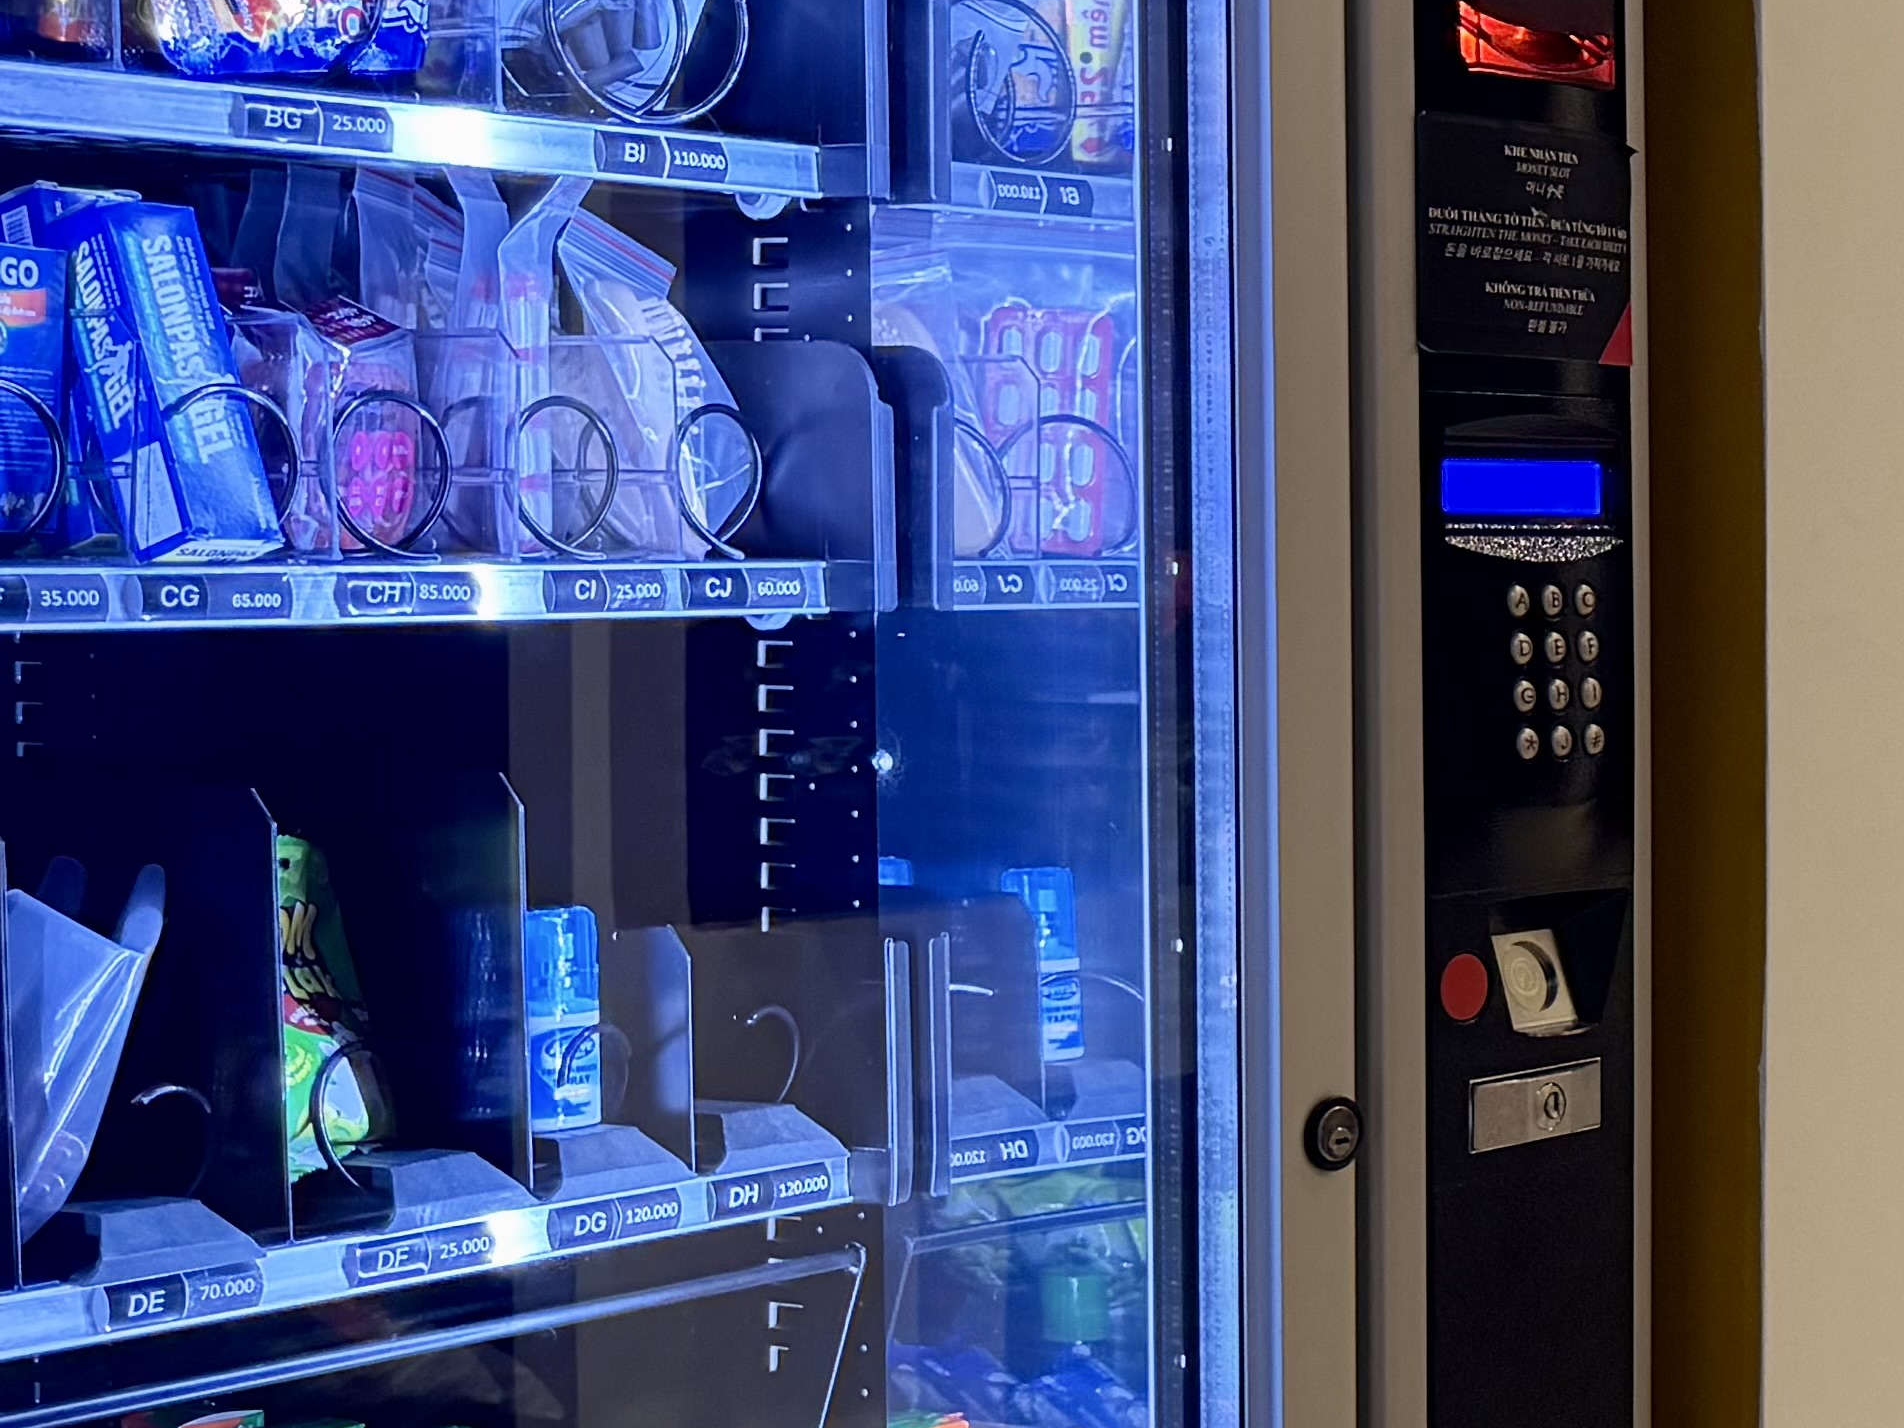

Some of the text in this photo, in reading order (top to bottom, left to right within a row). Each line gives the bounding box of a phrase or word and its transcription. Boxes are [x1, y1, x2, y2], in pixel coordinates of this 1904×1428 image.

[264, 106, 386, 133] BG 25.000
[624, 143, 726, 170] BI 110.000
[142, 234, 198, 378] SALONPAS
[40, 590, 99, 607] 35.000
[161, 585, 281, 609] CG 65.000
[367, 582, 471, 605] CH 85.000
[575, 580, 661, 600] CI 25.000
[705, 576, 801, 599] CJ 60.000
[1516, 592, 1595, 609] A B C
[1519, 636, 1596, 658] D E F
[1522, 688, 1534, 704] G
[1557, 686, 1567, 703] H
[728, 1174, 828, 1208] DH 120.000
[574, 1201, 678, 1236] DG 120.000
[439, 1236, 490, 1260] 25.000
[127, 1278, 256, 1317] DE 70.000
